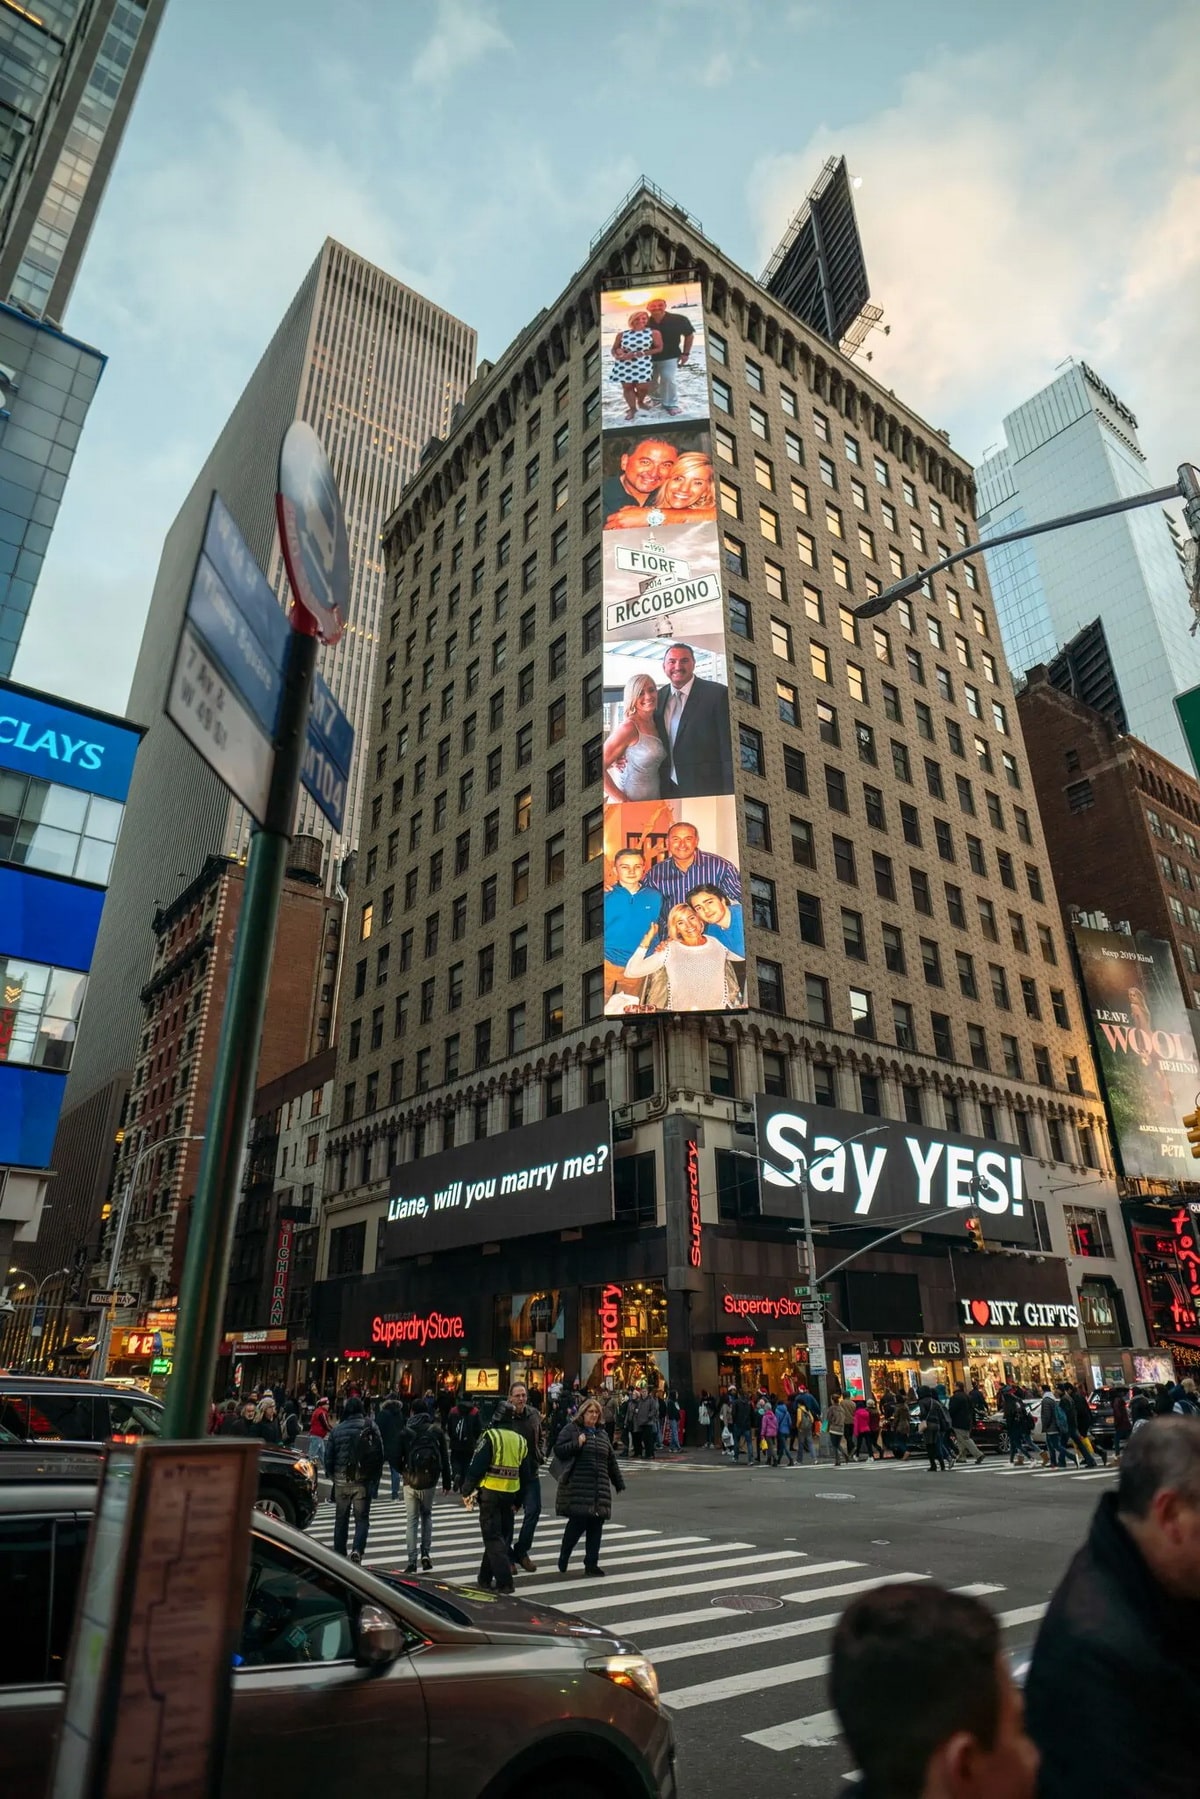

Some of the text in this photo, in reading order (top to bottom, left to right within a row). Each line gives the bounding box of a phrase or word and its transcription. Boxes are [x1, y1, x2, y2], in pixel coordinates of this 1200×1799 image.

[615, 580, 709, 623] RICCOBONO
[0, 715, 105, 770] CLAYS
[1101, 947, 1119, 959] Keep
[1119, 951, 1136, 961] 2019
[1096, 1009, 1129, 1024] LEAVE
[1099, 1022, 1194, 1061] WOOL
[1159, 1060, 1198, 1074] BEHIND
[763, 1113, 1024, 1217] Say YES!
[387, 1144, 609, 1222] Liane, will you marry me?
[270, 1234, 289, 1326] ICHIRAN
[724, 1294, 801, 1318] SuperdryStor
[961, 1299, 974, 1325] I
[1024, 1303, 1079, 1328] GIFTS
[928, 1341, 961, 1354] GIFTS
